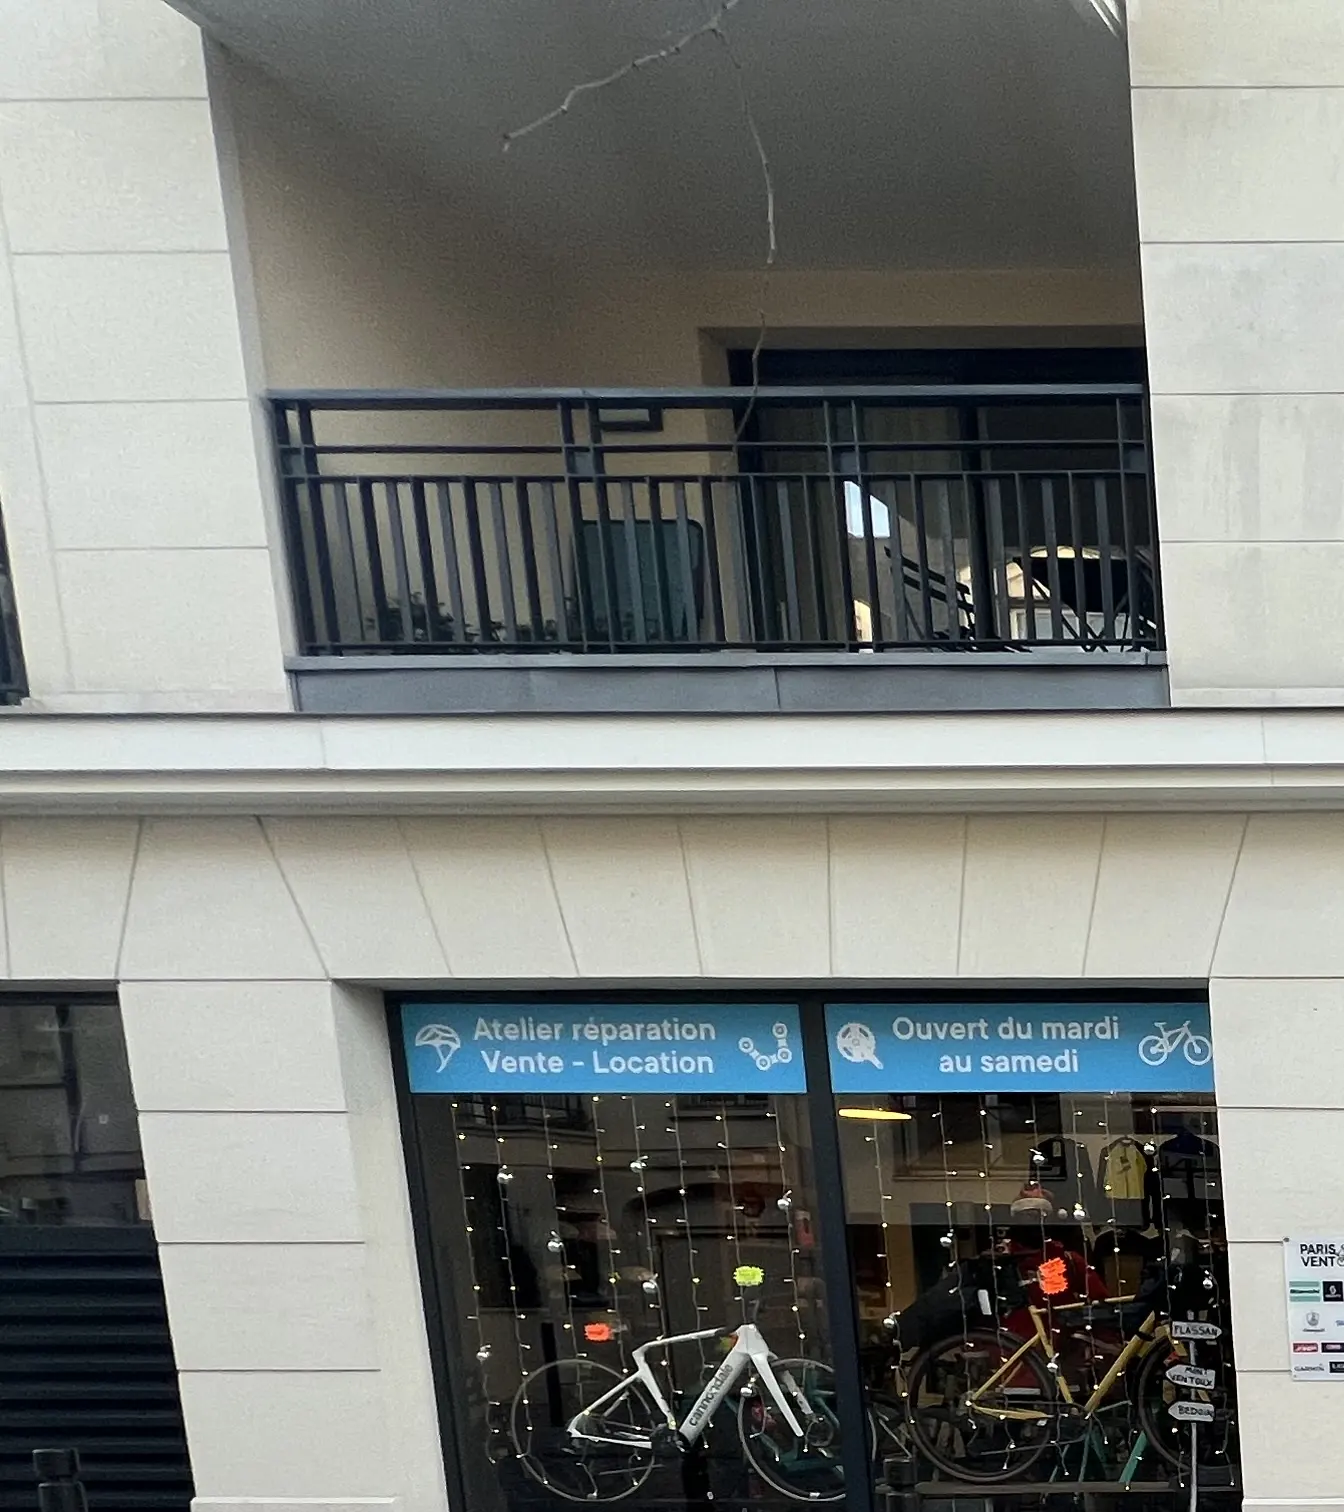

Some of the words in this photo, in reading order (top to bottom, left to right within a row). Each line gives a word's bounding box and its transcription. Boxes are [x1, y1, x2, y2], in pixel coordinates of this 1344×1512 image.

[473, 1016, 569, 1041] Atelier
[572, 1016, 716, 1047] réparation
[892, 1016, 988, 1041] Ouvert
[997, 1016, 1033, 1041] du
[1042, 1015, 1119, 1041] mardi
[480, 1050, 564, 1074] Vente
[593, 1049, 715, 1074] Location
[939, 1053, 972, 1073] au
[980, 1049, 1079, 1073] samedi
[1300, 1243, 1336, 1255] PARIS
[1174, 1324, 1218, 1336] FLASSAN
[689, 1364, 733, 1427] cannondale
